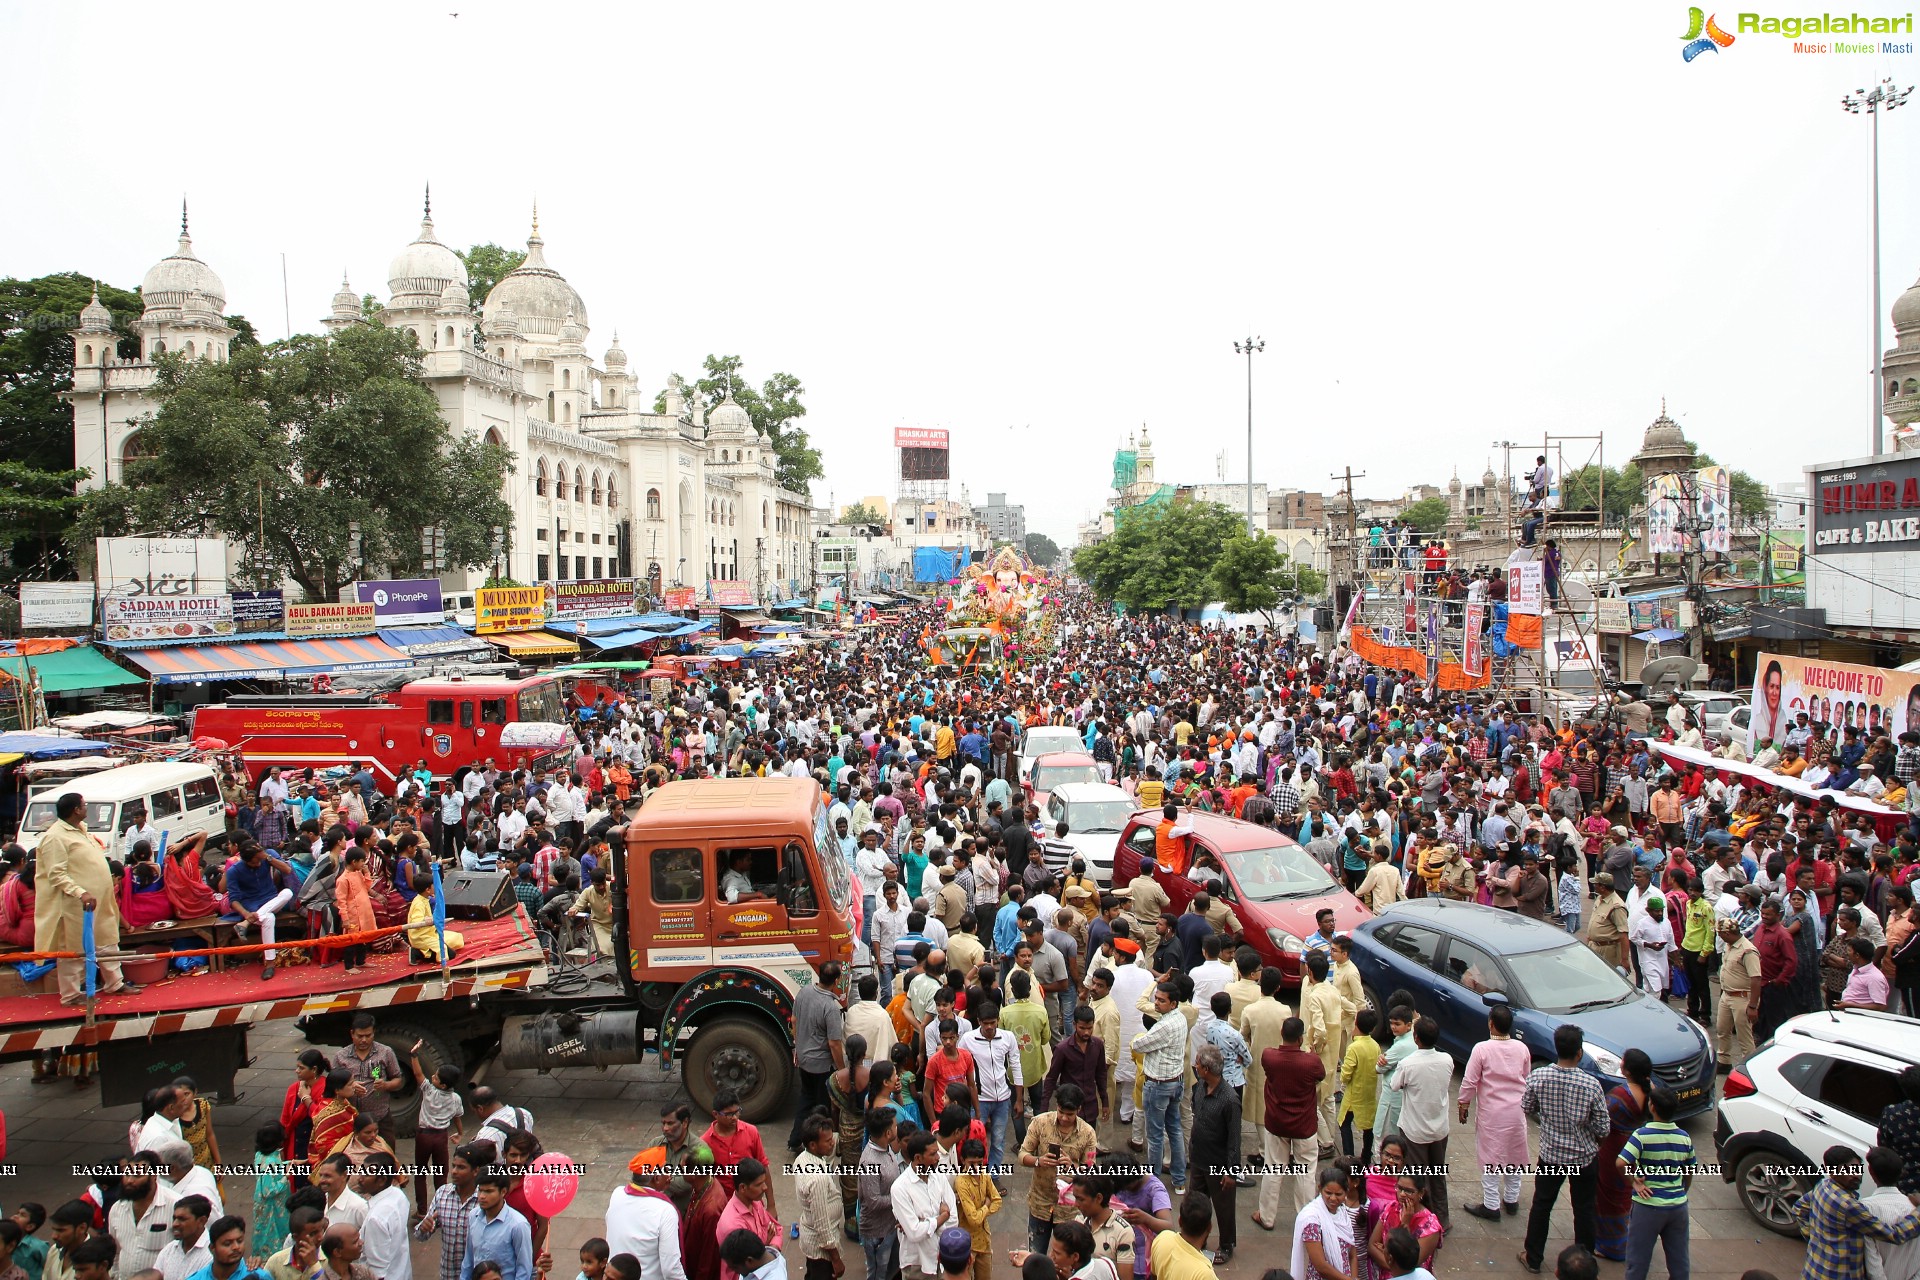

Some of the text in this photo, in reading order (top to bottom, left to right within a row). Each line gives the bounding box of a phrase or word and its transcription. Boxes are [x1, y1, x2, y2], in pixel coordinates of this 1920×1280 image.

[898, 429, 946, 439] BHASKAR ARTS
[1843, 472, 1857, 481] 1993
[1815, 528, 1850, 546] CAFE
[1851, 527, 1863, 544] &
[127, 571, 197, 597] اعتماد
[557, 584, 606, 596] MUQADDAR
[607, 582, 633, 593] HOTEL
[392, 592, 428, 602] PhonePe
[483, 590, 539, 606] MUNNU
[119, 600, 175, 612] SADDAM
[179, 599, 220, 610] HOTEL
[289, 608, 309, 618] ABUL
[311, 606, 345, 616] BARKAAT
[347, 605, 374, 616] BAKERY
[491, 606, 531, 617] PAN SHOP
[187, 609, 218, 617] AVAILABLE
[1804, 666, 1884, 697] WELCOME TO
[265, 710, 302, 718] తెలంగాణ
[734, 914, 769, 923] JANGAIAH
[547, 1038, 582, 1055] DIESEL
[560, 1044, 587, 1058] TANK
[146, 1061, 187, 1074] TOOL BOX
